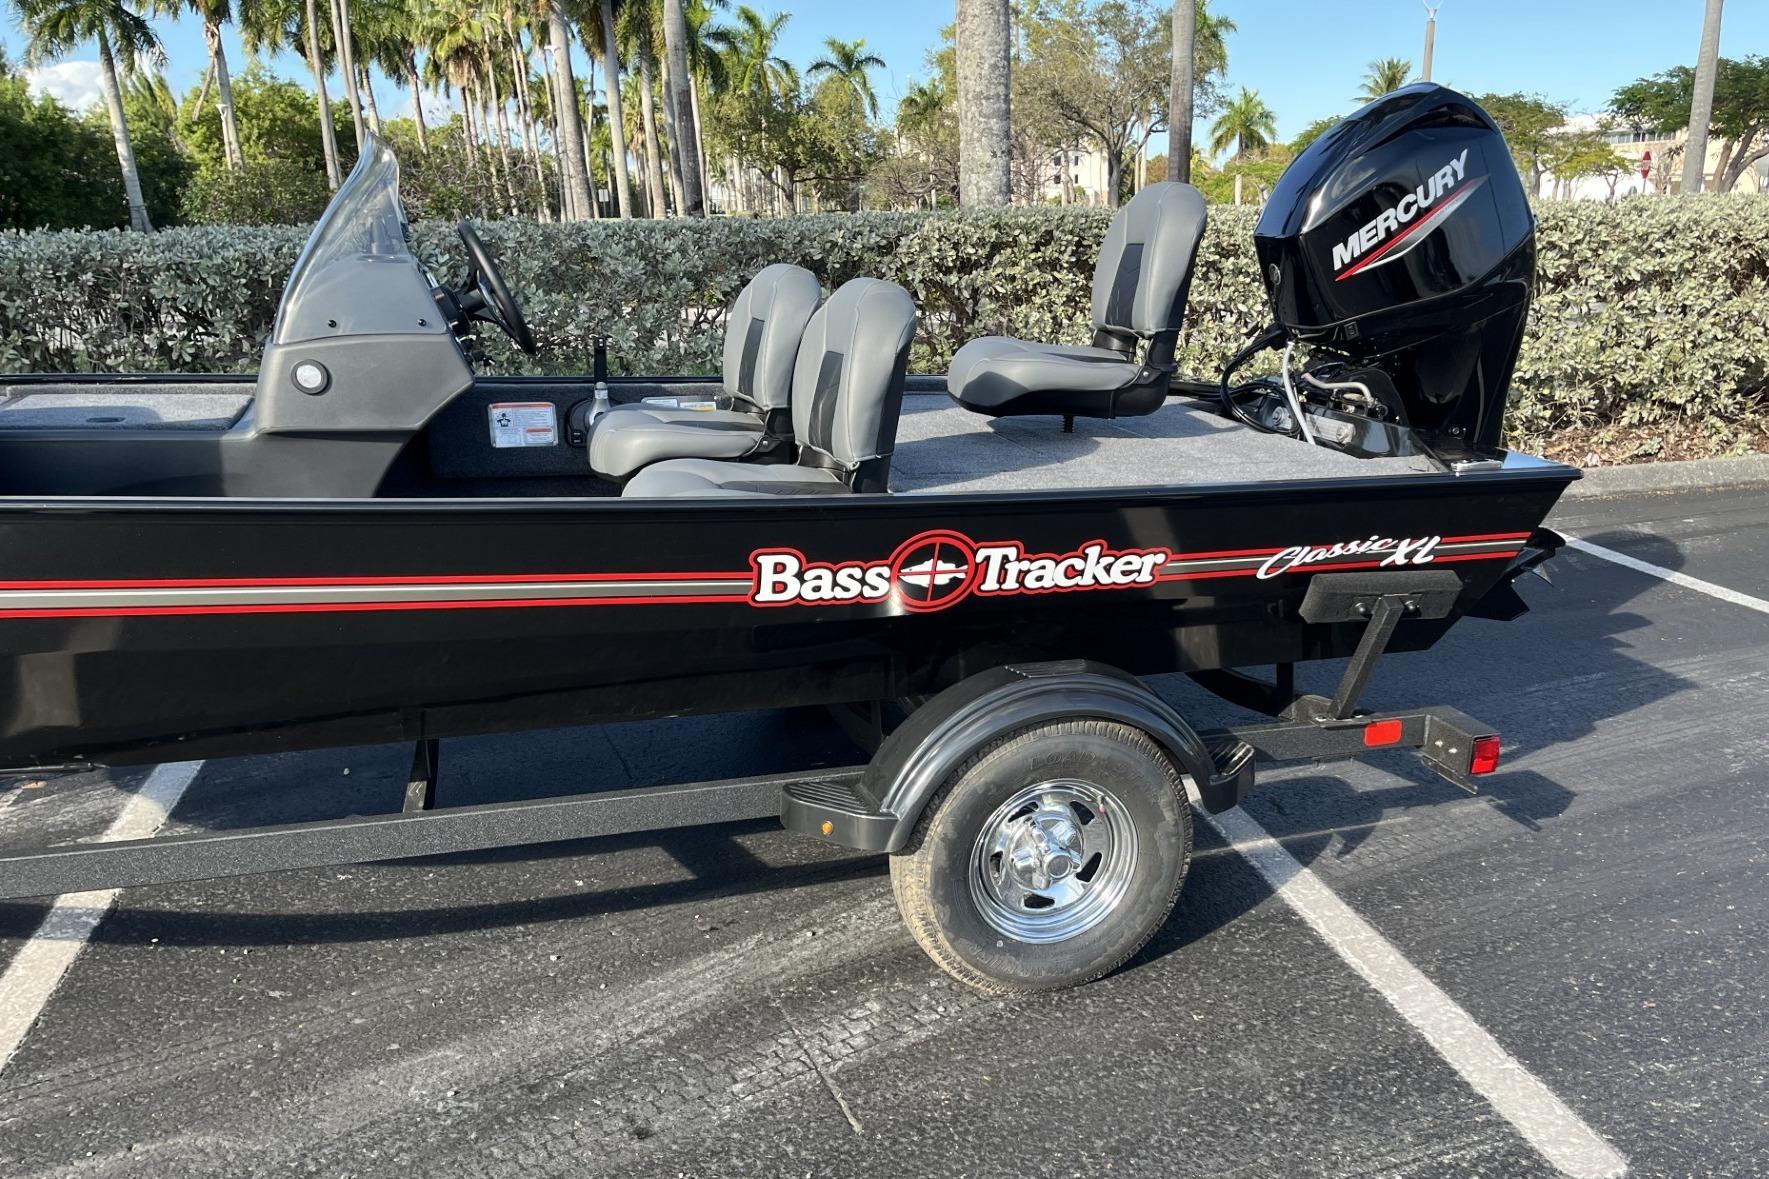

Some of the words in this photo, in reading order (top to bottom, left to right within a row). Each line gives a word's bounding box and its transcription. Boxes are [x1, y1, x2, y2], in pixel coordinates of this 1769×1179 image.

[1332, 148, 1468, 271] MERCURY
[754, 553, 891, 602] Bass
[975, 545, 1167, 592] Tracker
[1256, 535, 1399, 580] Classic
[1379, 535, 1441, 567] XL
